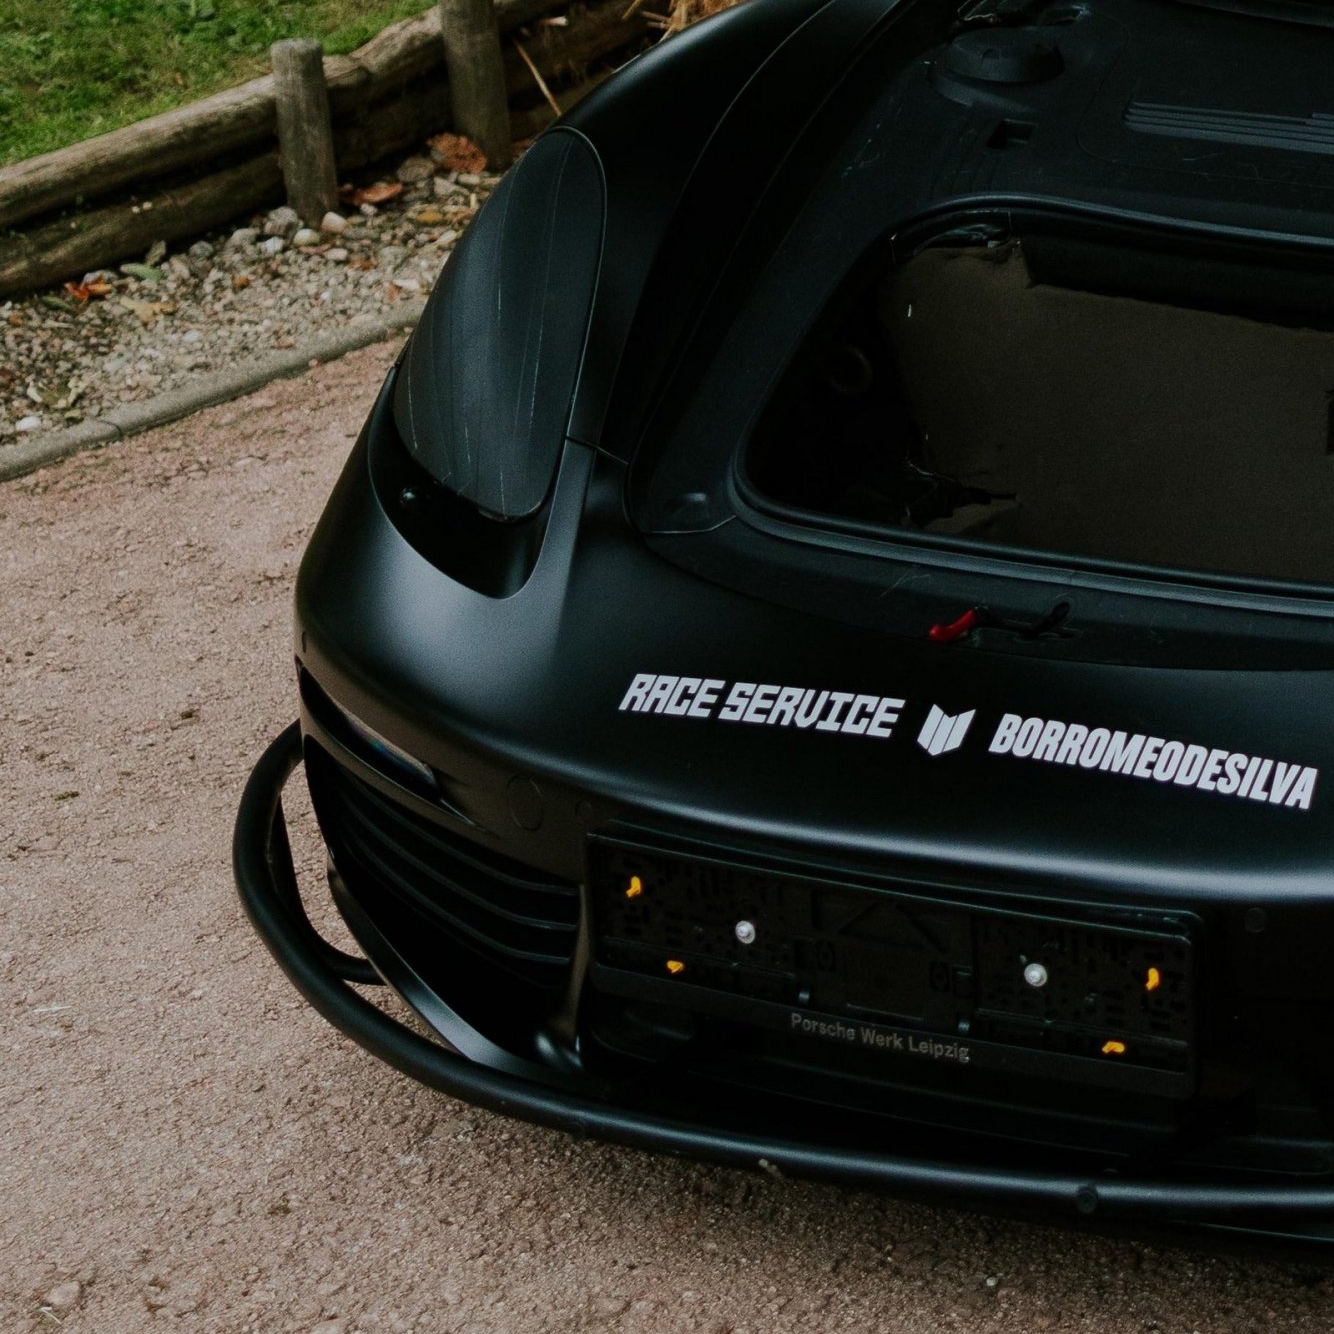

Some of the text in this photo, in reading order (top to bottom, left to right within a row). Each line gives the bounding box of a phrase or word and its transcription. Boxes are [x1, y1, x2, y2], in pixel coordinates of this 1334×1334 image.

[618, 673, 1320, 811] RACE SERVICE BORROMEODESILVA
[790, 1012, 971, 1064] Porsche Werk Leipzig
